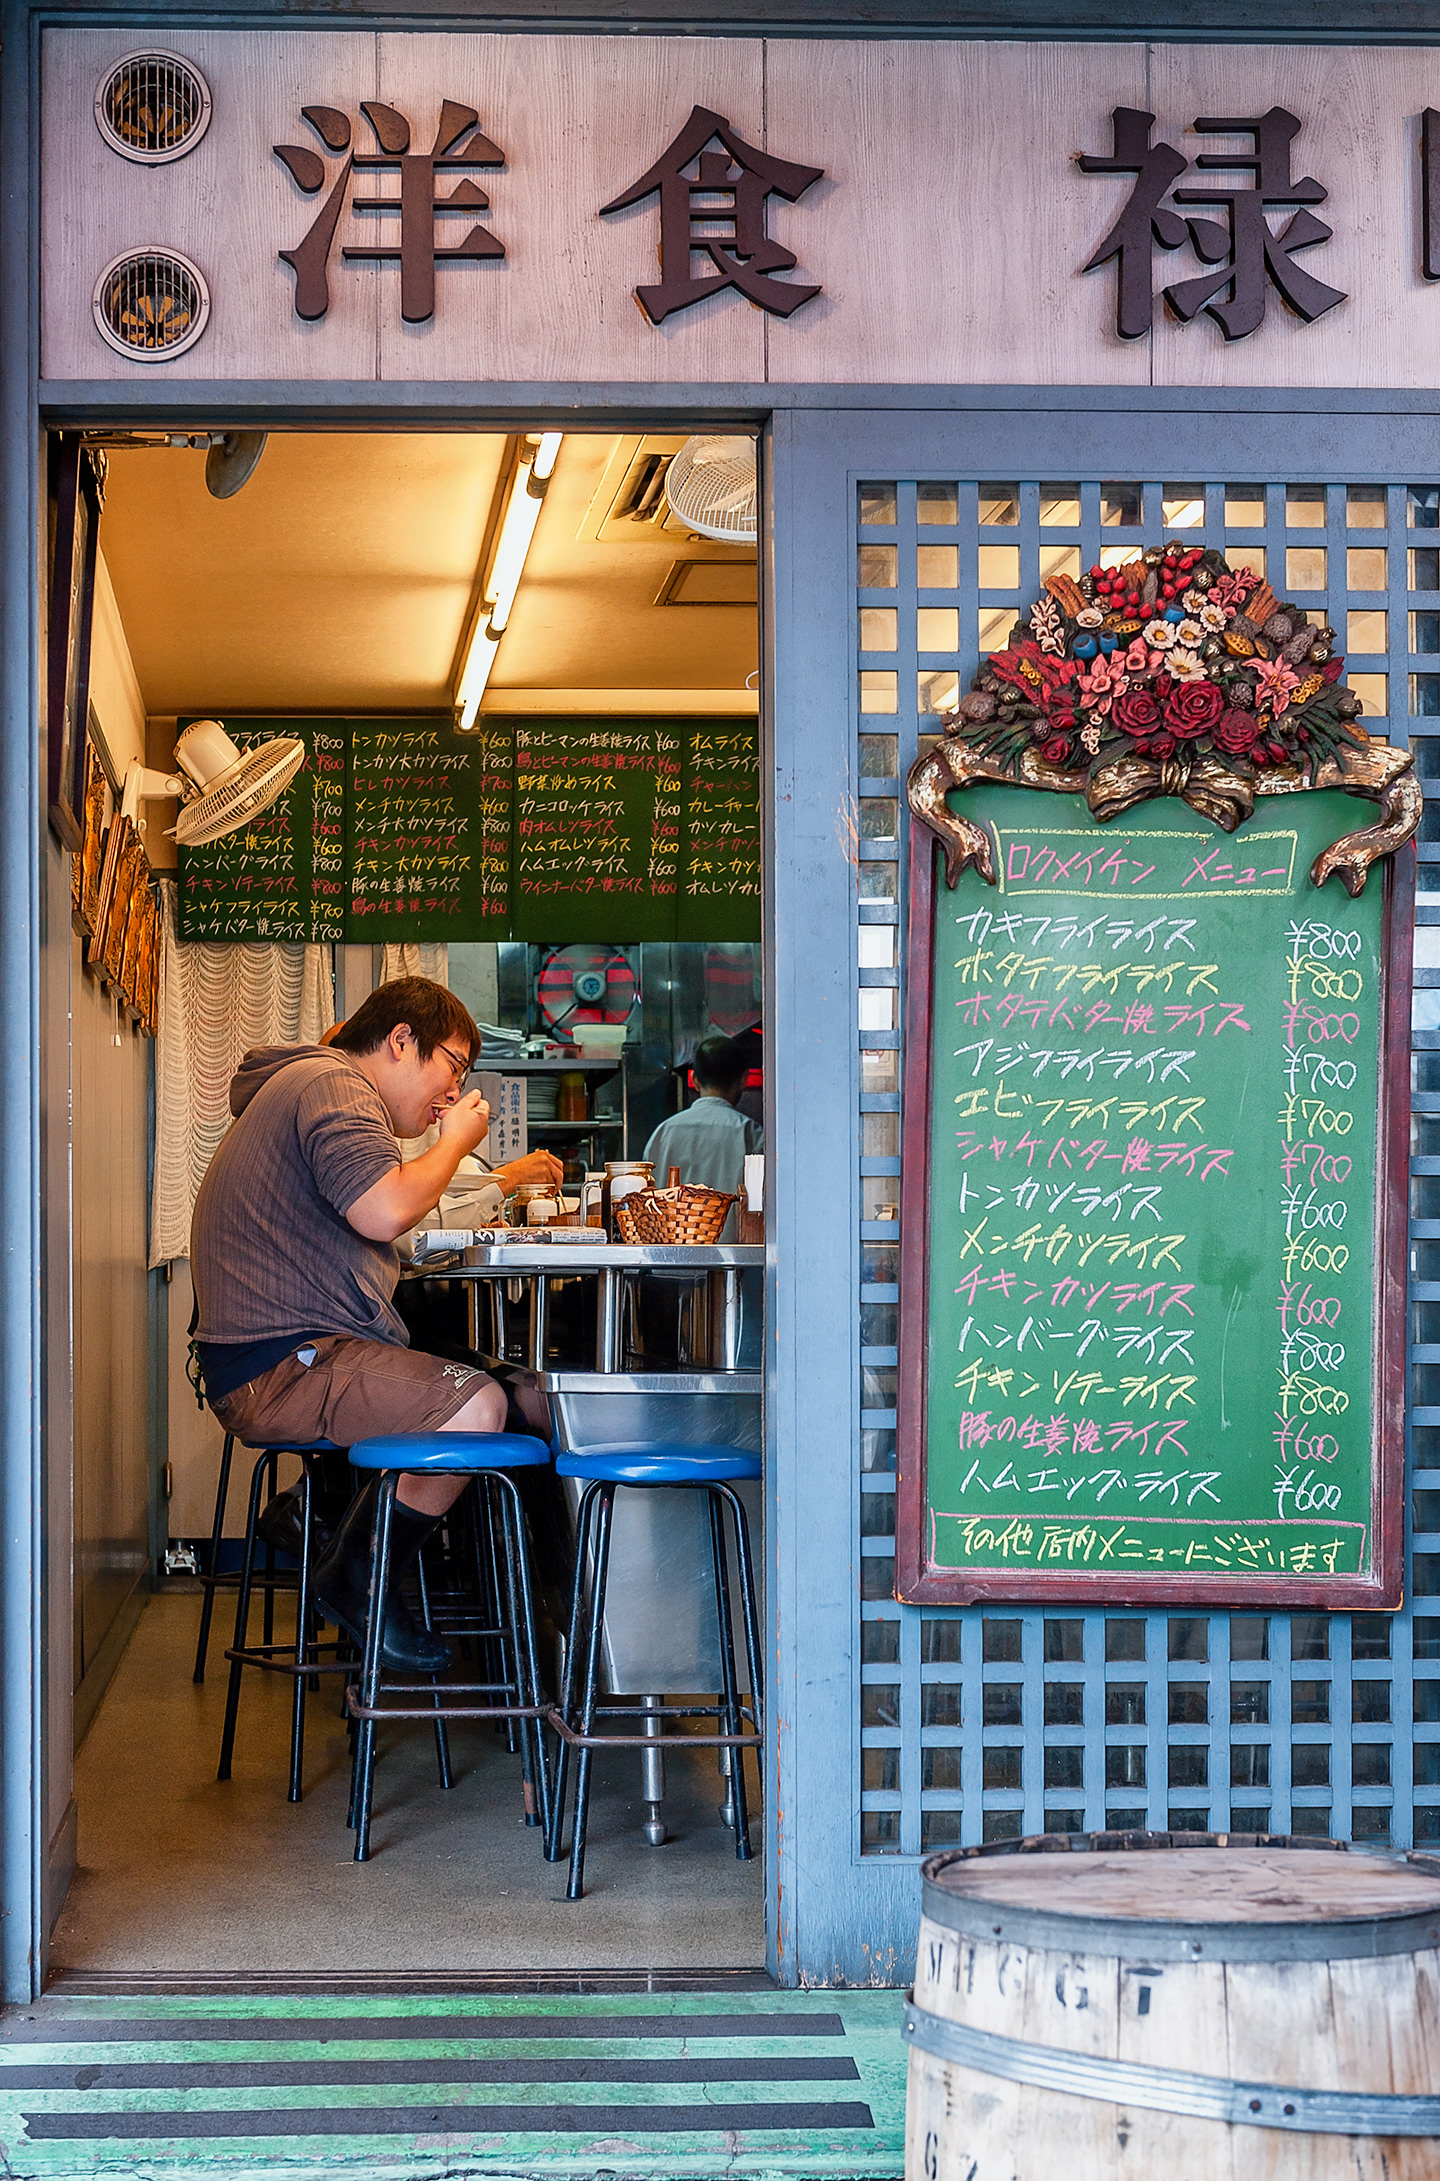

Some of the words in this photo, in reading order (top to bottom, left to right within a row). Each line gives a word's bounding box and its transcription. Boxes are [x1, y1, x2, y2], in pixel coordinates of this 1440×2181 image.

[1075, 106, 1440, 341] 禄
[312, 731, 344, 753] ¥800
[478, 730, 511, 751] ¥600
[655, 730, 680, 752] ¥600
[316, 753, 344, 773] ¥800
[481, 752, 512, 772] ¥800
[658, 755, 681, 775] ¥600
[312, 774, 343, 798] ¥700
[480, 773, 512, 792] ¥700
[655, 774, 681, 792] ¥600
[311, 798, 342, 818] ¥700
[479, 796, 509, 815] ¥600
[653, 797, 681, 819] ¥600
[311, 817, 341, 835] ¥600
[481, 816, 510, 836] ¥800
[651, 819, 679, 837] ¥600
[312, 835, 342, 856] ¥600
[482, 836, 508, 855] ¥600
[651, 836, 679, 856] ¥600
[311, 854, 342, 873] ¥800
[480, 856, 509, 875] ¥800
[647, 857, 677, 878] ¥600
[1006, 843, 1156, 885] ロクメイケン
[1181, 849, 1286, 887] メニュー
[311, 878, 342, 896] ¥800
[481, 875, 508, 895] ¥600
[651, 878, 677, 896] ¥600
[310, 900, 344, 920] ¥700
[481, 897, 507, 916] ¥600
[311, 920, 342, 941] ¥700
[956, 905, 1198, 953] カキフライライス
[1284, 918, 1361, 963] ¥800
[954, 947, 1219, 996] ホタテフライライス
[1286, 955, 1362, 1005] ¥800
[956, 990, 1251, 1036] ホタテバター焼ライス
[1281, 998, 1360, 1048] ¥800
[953, 1038, 1196, 1083] アジフライライス
[1281, 1043, 1357, 1095] ¥700
[954, 1079, 1206, 1134] エビフライライス
[1278, 1091, 1353, 1142] ¥700
[1280, 1140, 1351, 1186] ¥700
[958, 1172, 1164, 1222] トンカツライス
[1280, 1183, 1347, 1234] ¥600
[959, 1216, 1186, 1272] メンチカツライス
[1281, 1230, 1350, 1282] ¥600
[954, 1263, 1196, 1318] チキンカツライス
[1275, 1280, 1342, 1328] ¥600
[957, 1315, 1195, 1366] ハンバーグライス
[1279, 1327, 1346, 1375] ¥800
[954, 1357, 1199, 1411] チキンソテーライス
[1277, 1368, 1350, 1418] ¥800
[1272, 1411, 1340, 1463] ¥600
[959, 1458, 1221, 1507] ハムエッグライス
[1271, 1464, 1342, 1519] ¥600
